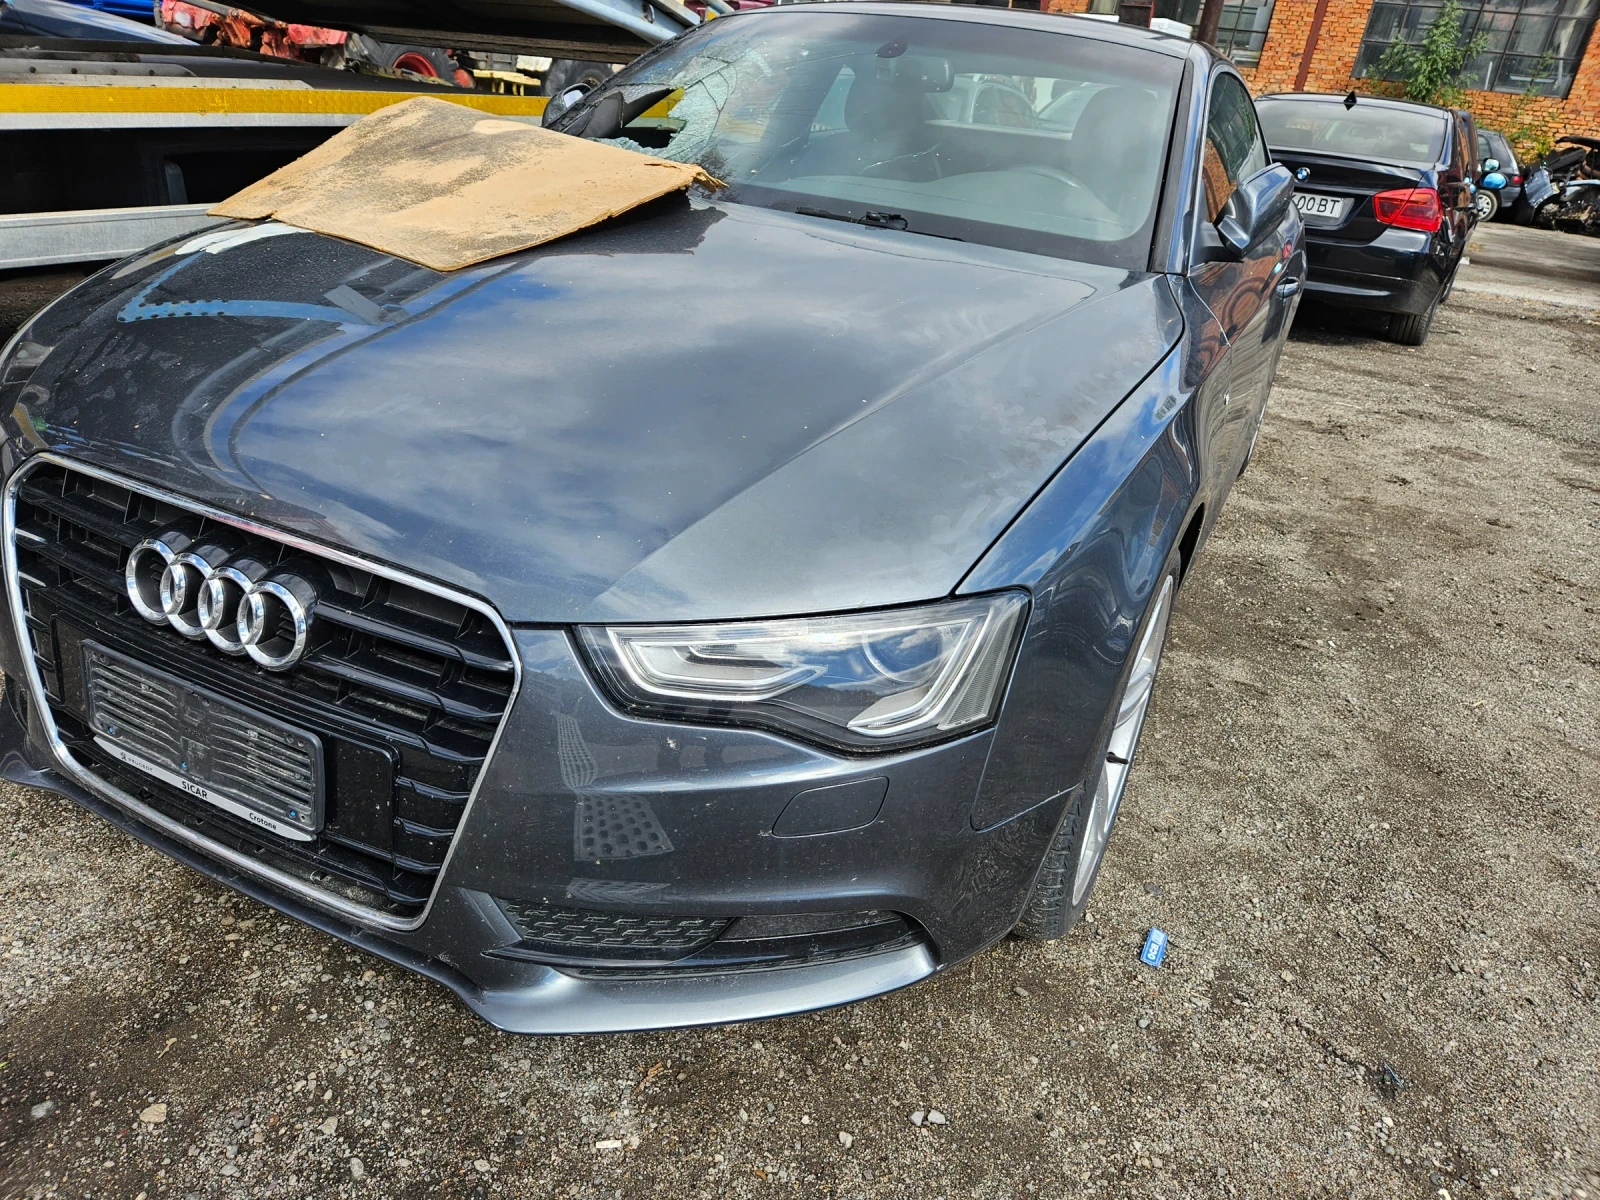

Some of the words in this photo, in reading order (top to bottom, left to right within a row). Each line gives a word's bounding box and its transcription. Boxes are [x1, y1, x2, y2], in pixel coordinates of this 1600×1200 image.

[181, 780, 208, 799] SICAR
[248, 812, 277, 831] Crotone
[1147, 942, 1160, 962] OCB
